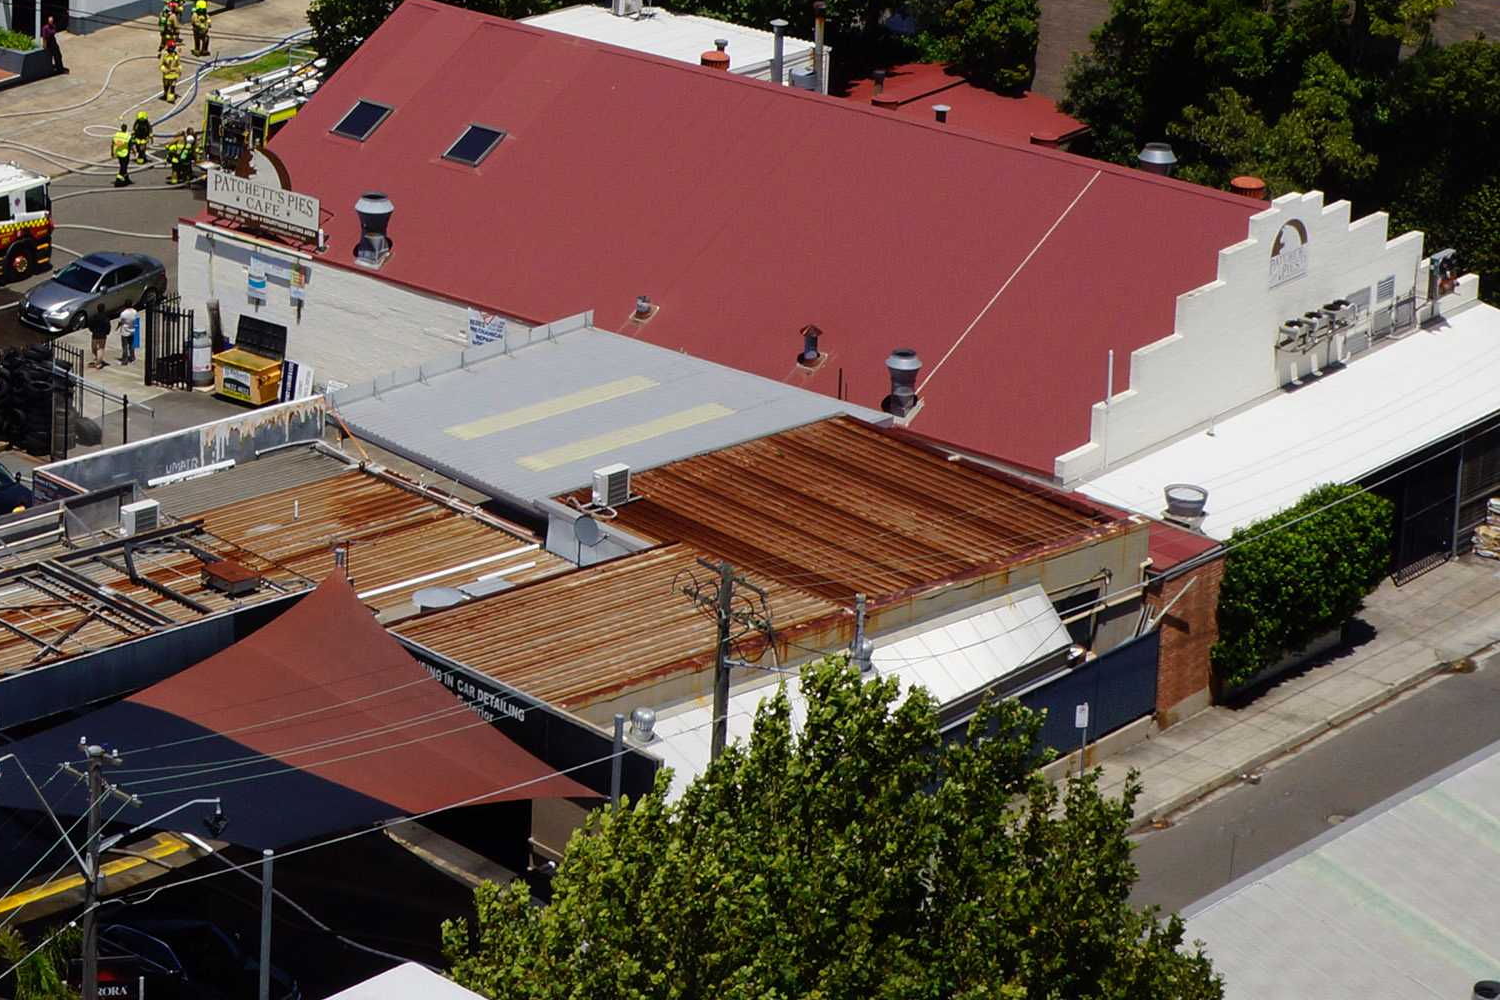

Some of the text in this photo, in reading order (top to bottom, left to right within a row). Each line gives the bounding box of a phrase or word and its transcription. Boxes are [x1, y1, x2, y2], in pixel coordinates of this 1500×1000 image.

[214, 173, 285, 205] PATCHETT'S
[287, 190, 314, 218] PIES
[246, 197, 280, 218] CAFE
[444, 672, 454, 688] IN
[457, 680, 476, 699] CAR
[477, 689, 525, 722] DETAILING
